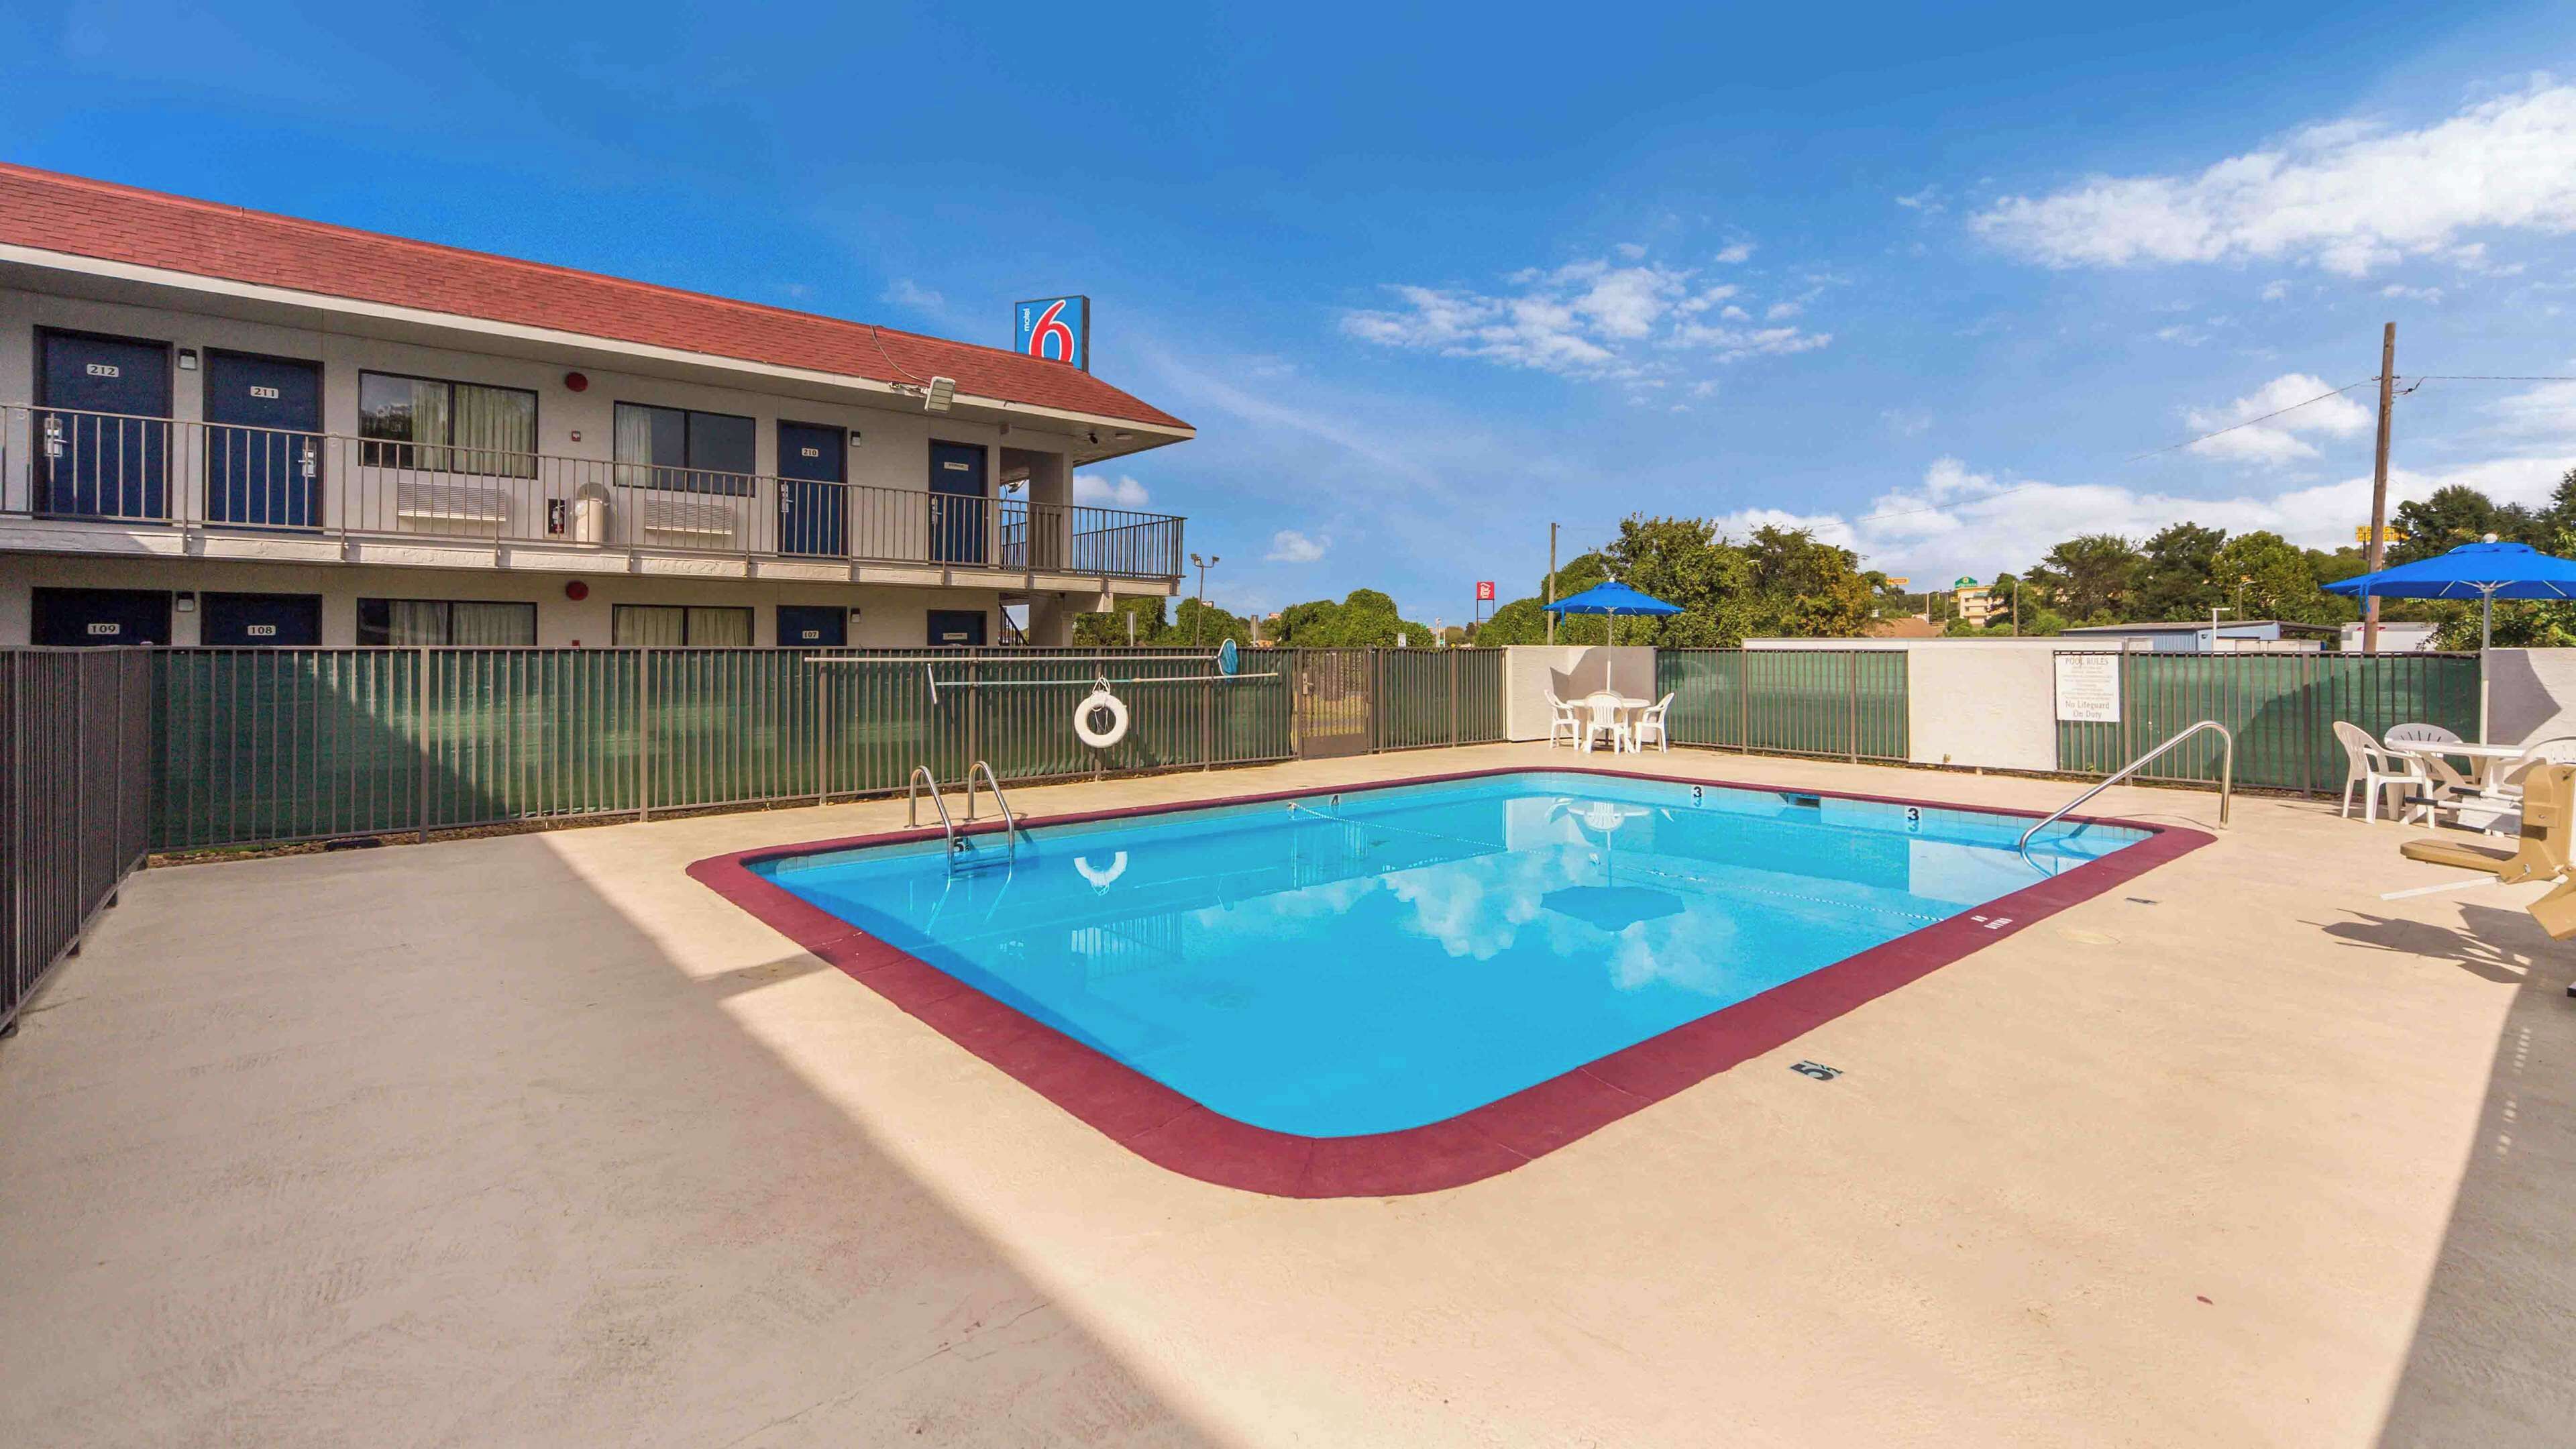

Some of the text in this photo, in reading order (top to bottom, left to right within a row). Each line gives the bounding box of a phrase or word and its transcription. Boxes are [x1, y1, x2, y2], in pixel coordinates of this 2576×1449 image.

[1022, 308, 1030, 331] motel
[1028, 299, 1075, 362] 6
[91, 366, 115, 376] 212
[254, 388, 274, 397] 211
[91, 625, 116, 633] 109
[252, 627, 272, 635] 108
[2065, 657, 2109, 665] POOL RULES
[2065, 700, 2110, 710] No Lifeguard
[2073, 710, 2102, 718] On Duty
[1693, 786, 1702, 798] 3
[1908, 808, 1919, 820] 3
